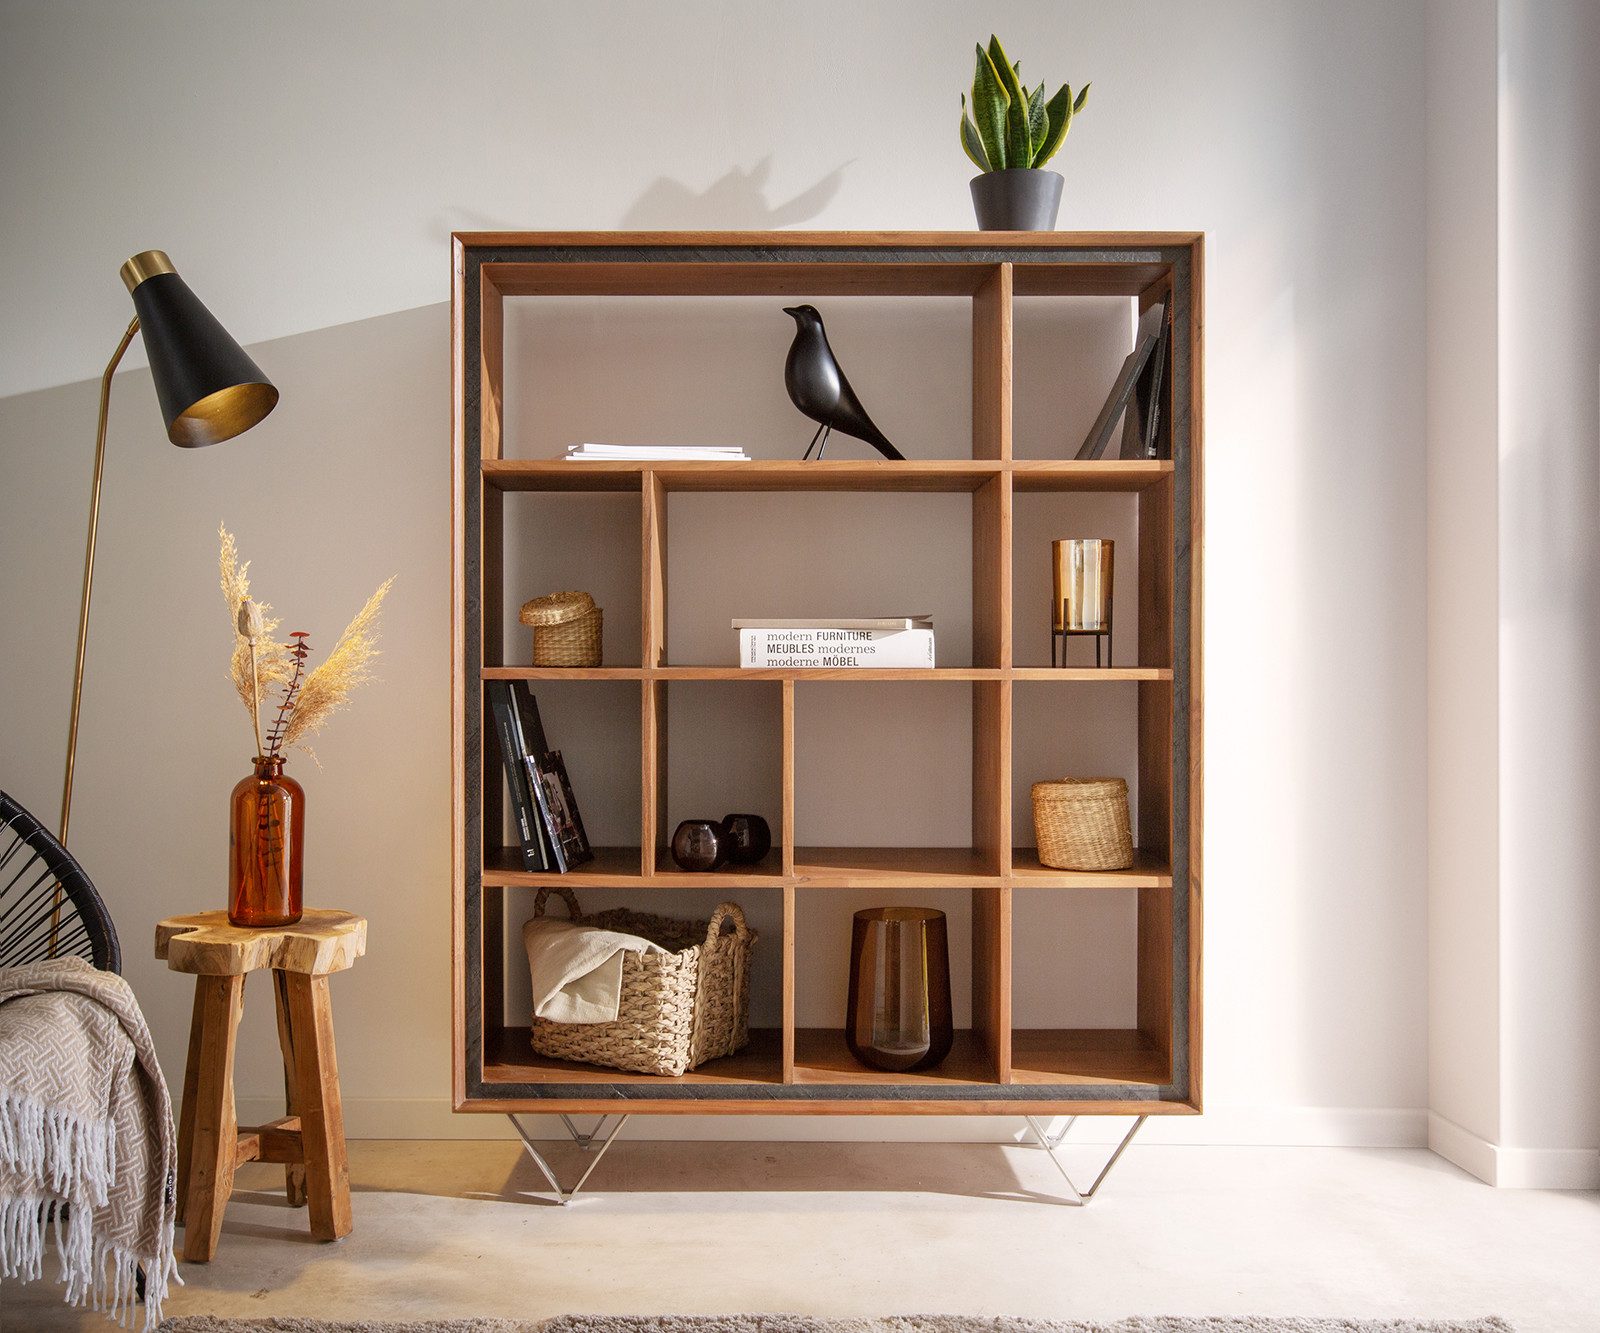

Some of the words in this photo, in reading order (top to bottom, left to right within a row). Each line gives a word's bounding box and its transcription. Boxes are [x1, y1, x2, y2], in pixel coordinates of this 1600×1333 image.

[766, 631, 813, 641] modern
[816, 631, 873, 641] FURNITURE
[766, 643, 815, 654] MEUBLES
[817, 643, 877, 654] modernes
[766, 656, 820, 667] moderne
[822, 654, 860, 667] MÖBEL
